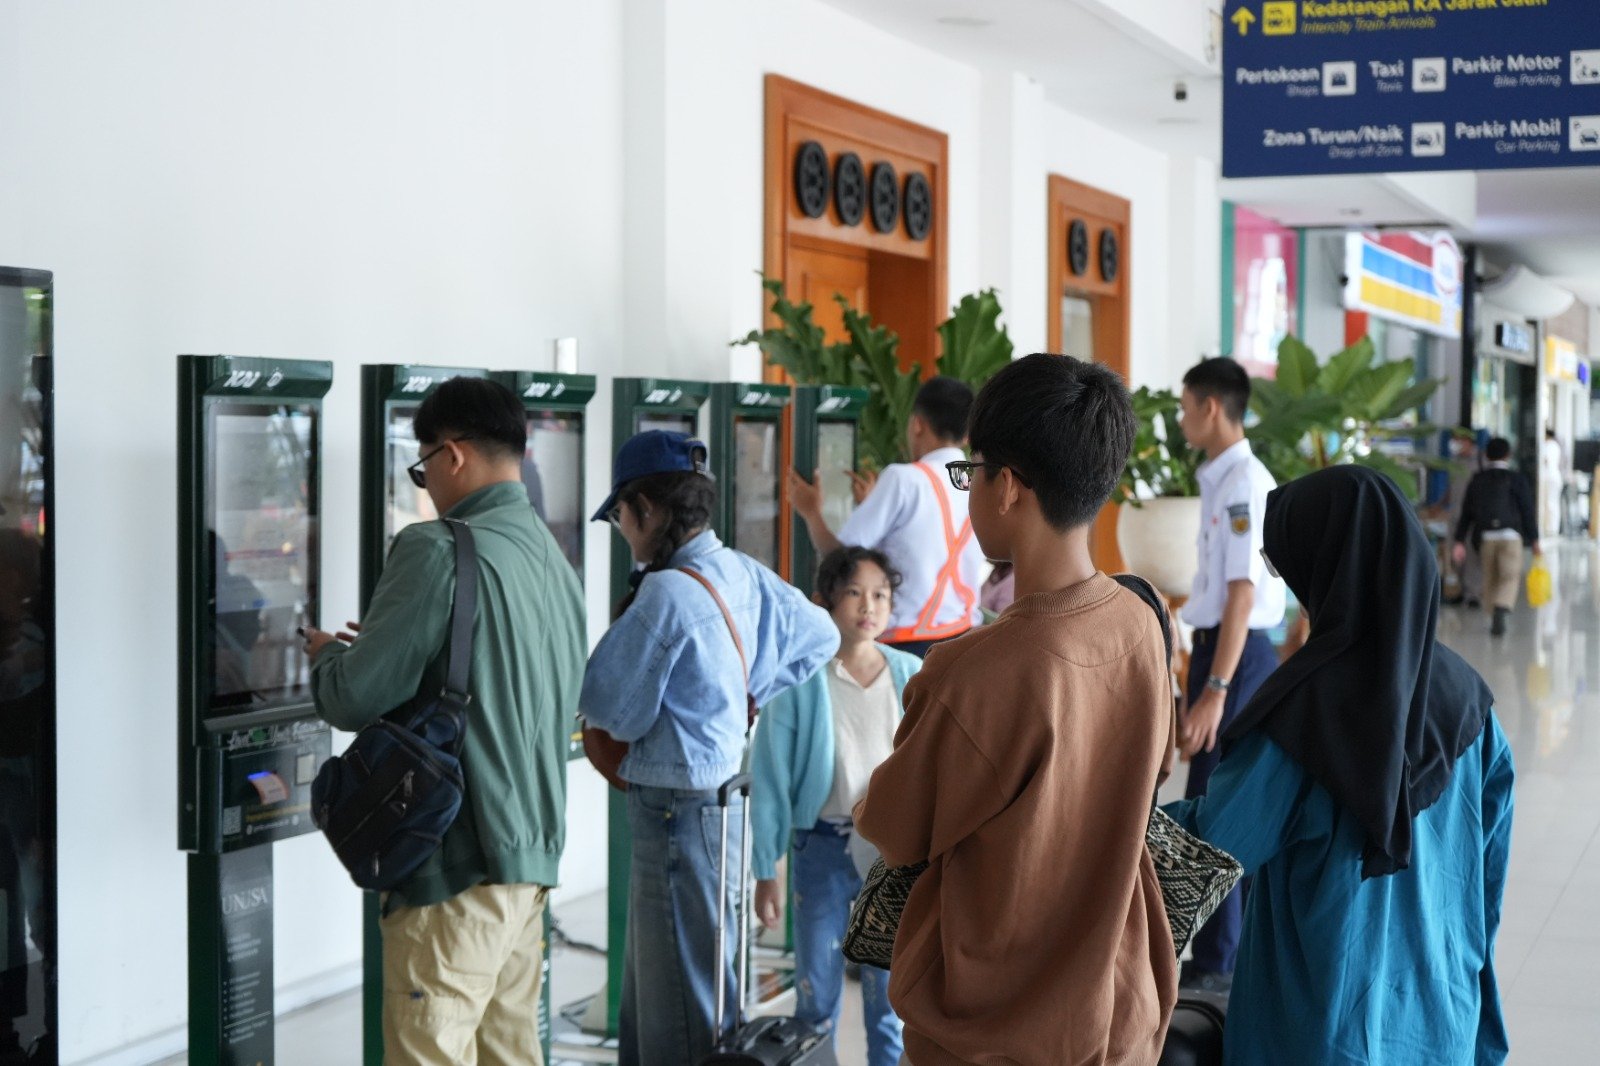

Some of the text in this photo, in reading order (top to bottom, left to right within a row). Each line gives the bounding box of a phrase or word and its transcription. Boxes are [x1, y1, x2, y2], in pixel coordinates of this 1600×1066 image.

[1302, 0, 1409, 18] Kedatangan
[1413, 0, 1442, 12] KA
[1302, 15, 1436, 35] Intercity Train Arrivals
[1369, 60, 1404, 78] Taxi
[1452, 54, 1562, 74] Parkir Motor
[1236, 66, 1320, 85] Pertokoan
[1519, 72, 1561, 88] Parking
[1263, 124, 1404, 147] Zona Turun/Naik
[1455, 118, 1561, 139] Parkir Mobil
[1518, 138, 1560, 154] Parking
